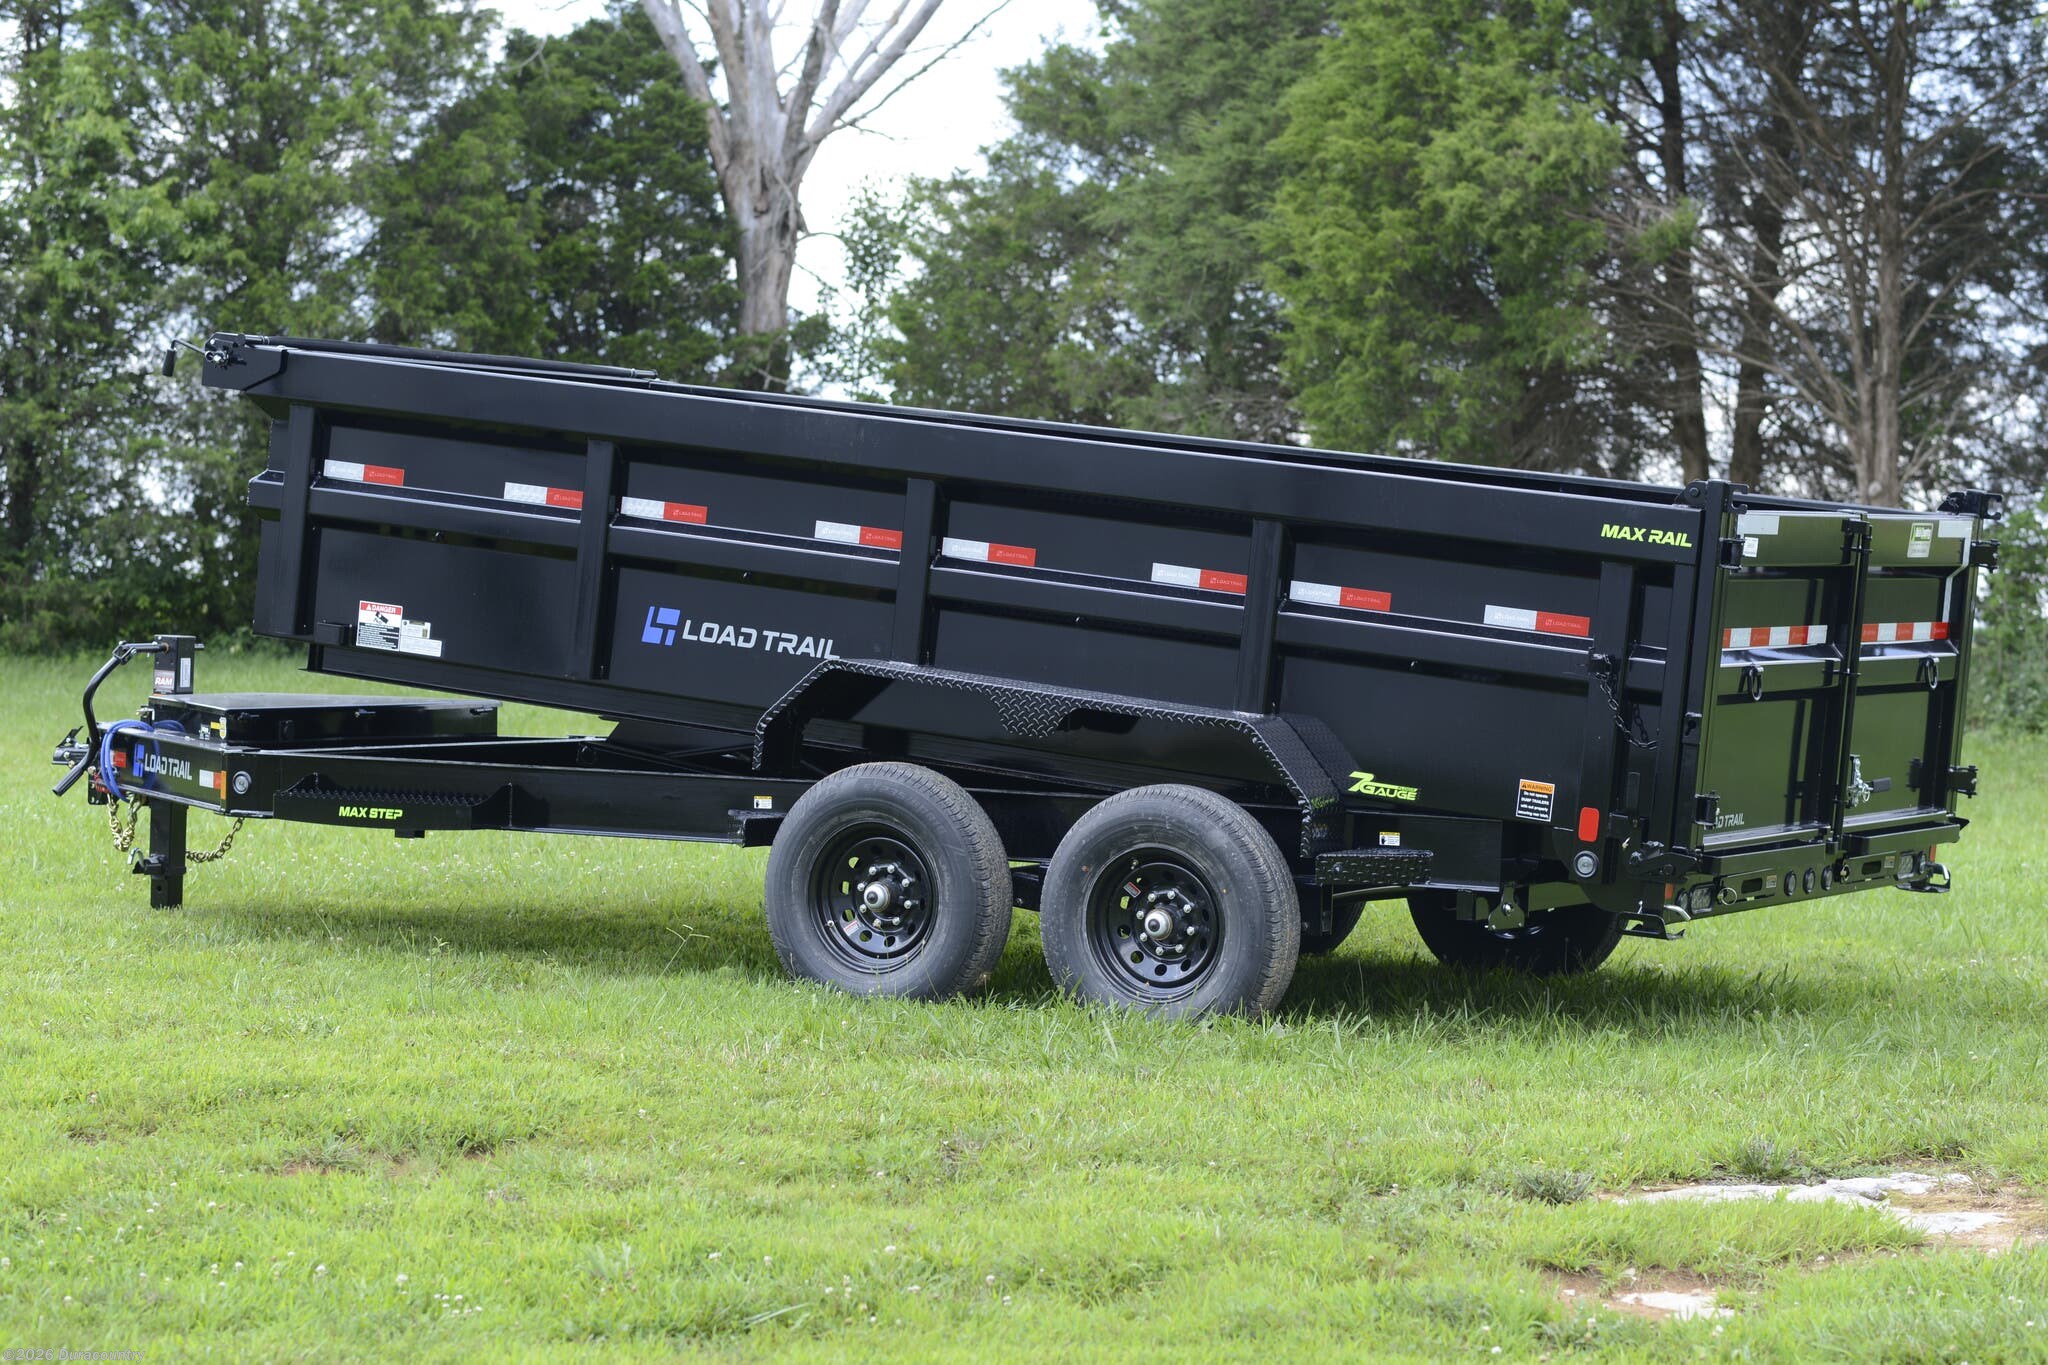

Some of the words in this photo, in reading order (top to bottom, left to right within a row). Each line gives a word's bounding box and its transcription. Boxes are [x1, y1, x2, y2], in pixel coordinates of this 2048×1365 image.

[1600, 523, 1647, 542] MAX
[1648, 529, 1692, 548] RAIL
[371, 604, 397, 614] DANGER
[682, 619, 757, 649] LOAD
[763, 630, 840, 659] TRAIL
[154, 677, 173, 685] RAM
[144, 753, 167, 775] LOAD
[168, 758, 192, 780] TRAIL
[1348, 771, 1375, 792] 7
[1527, 783, 1552, 792] WARNING
[1359, 781, 1417, 801] GAUGE
[338, 806, 368, 818] MAX
[369, 808, 403, 820] STEP
[1724, 813, 1745, 828] TRAIL
